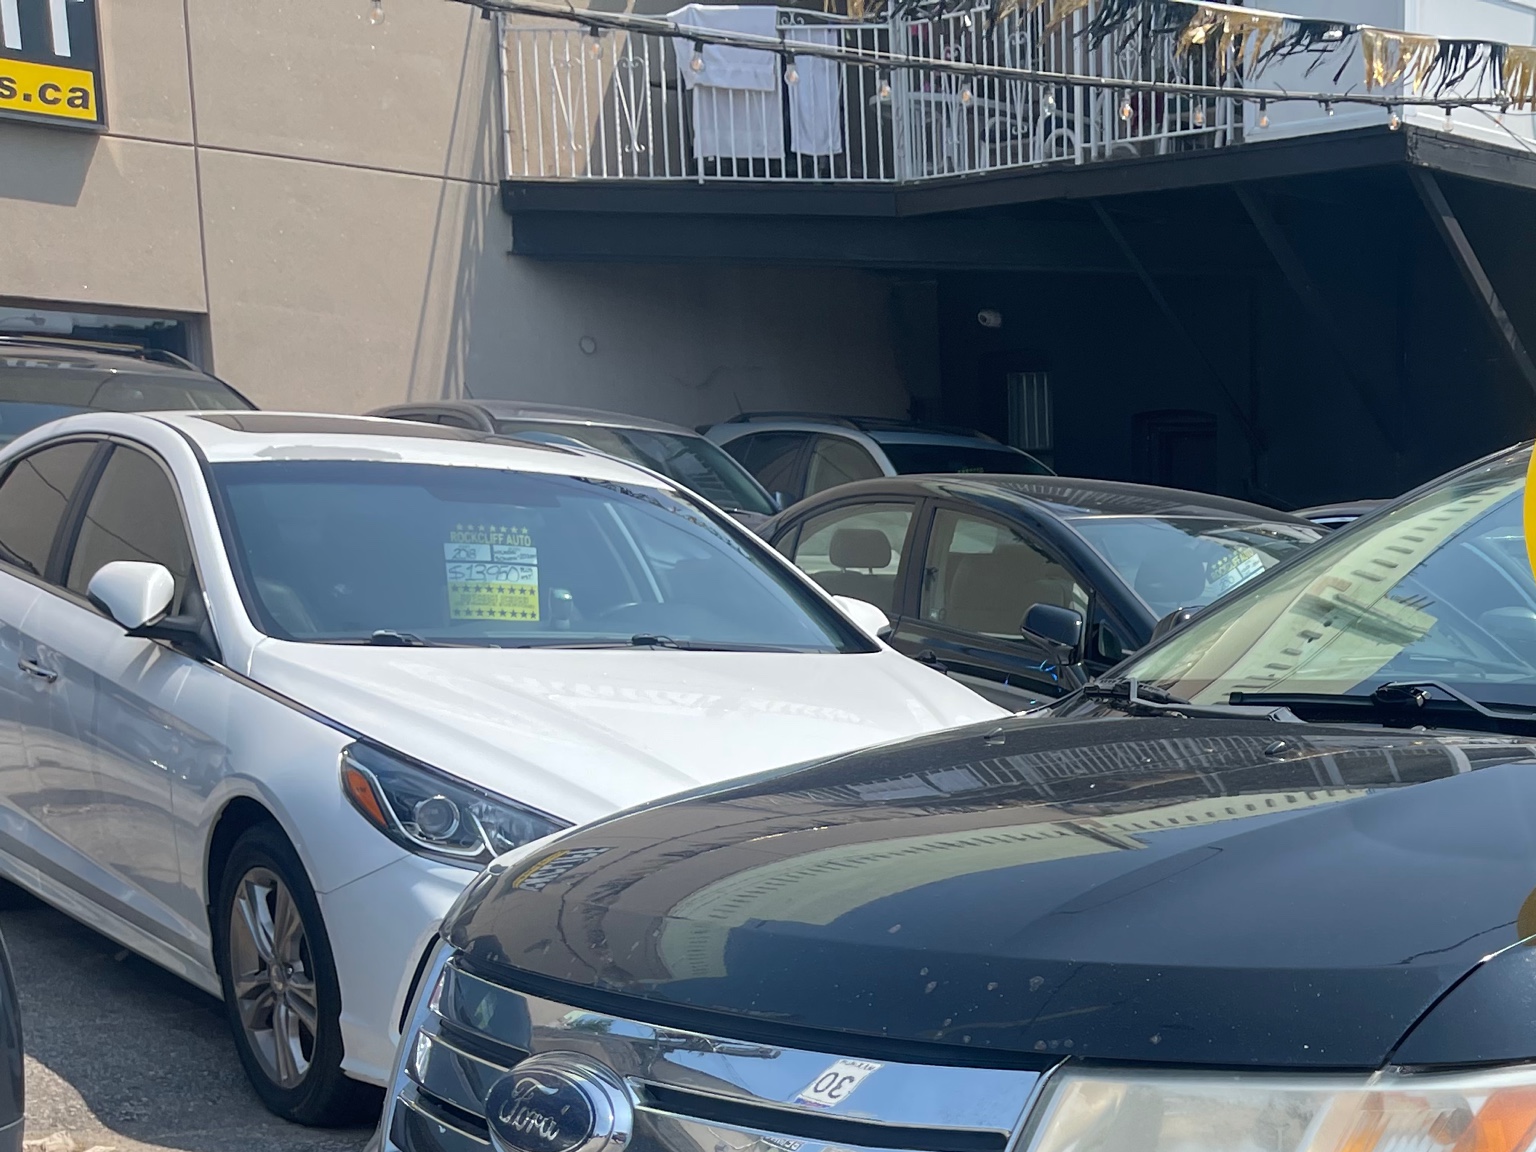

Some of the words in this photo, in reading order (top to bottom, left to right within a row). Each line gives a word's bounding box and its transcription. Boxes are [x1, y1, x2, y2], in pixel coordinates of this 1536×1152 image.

[450, 531, 504, 545] ROCKCLIFF
[506, 534, 532, 547] AUTO
[499, 1076, 570, 1141] Ford
